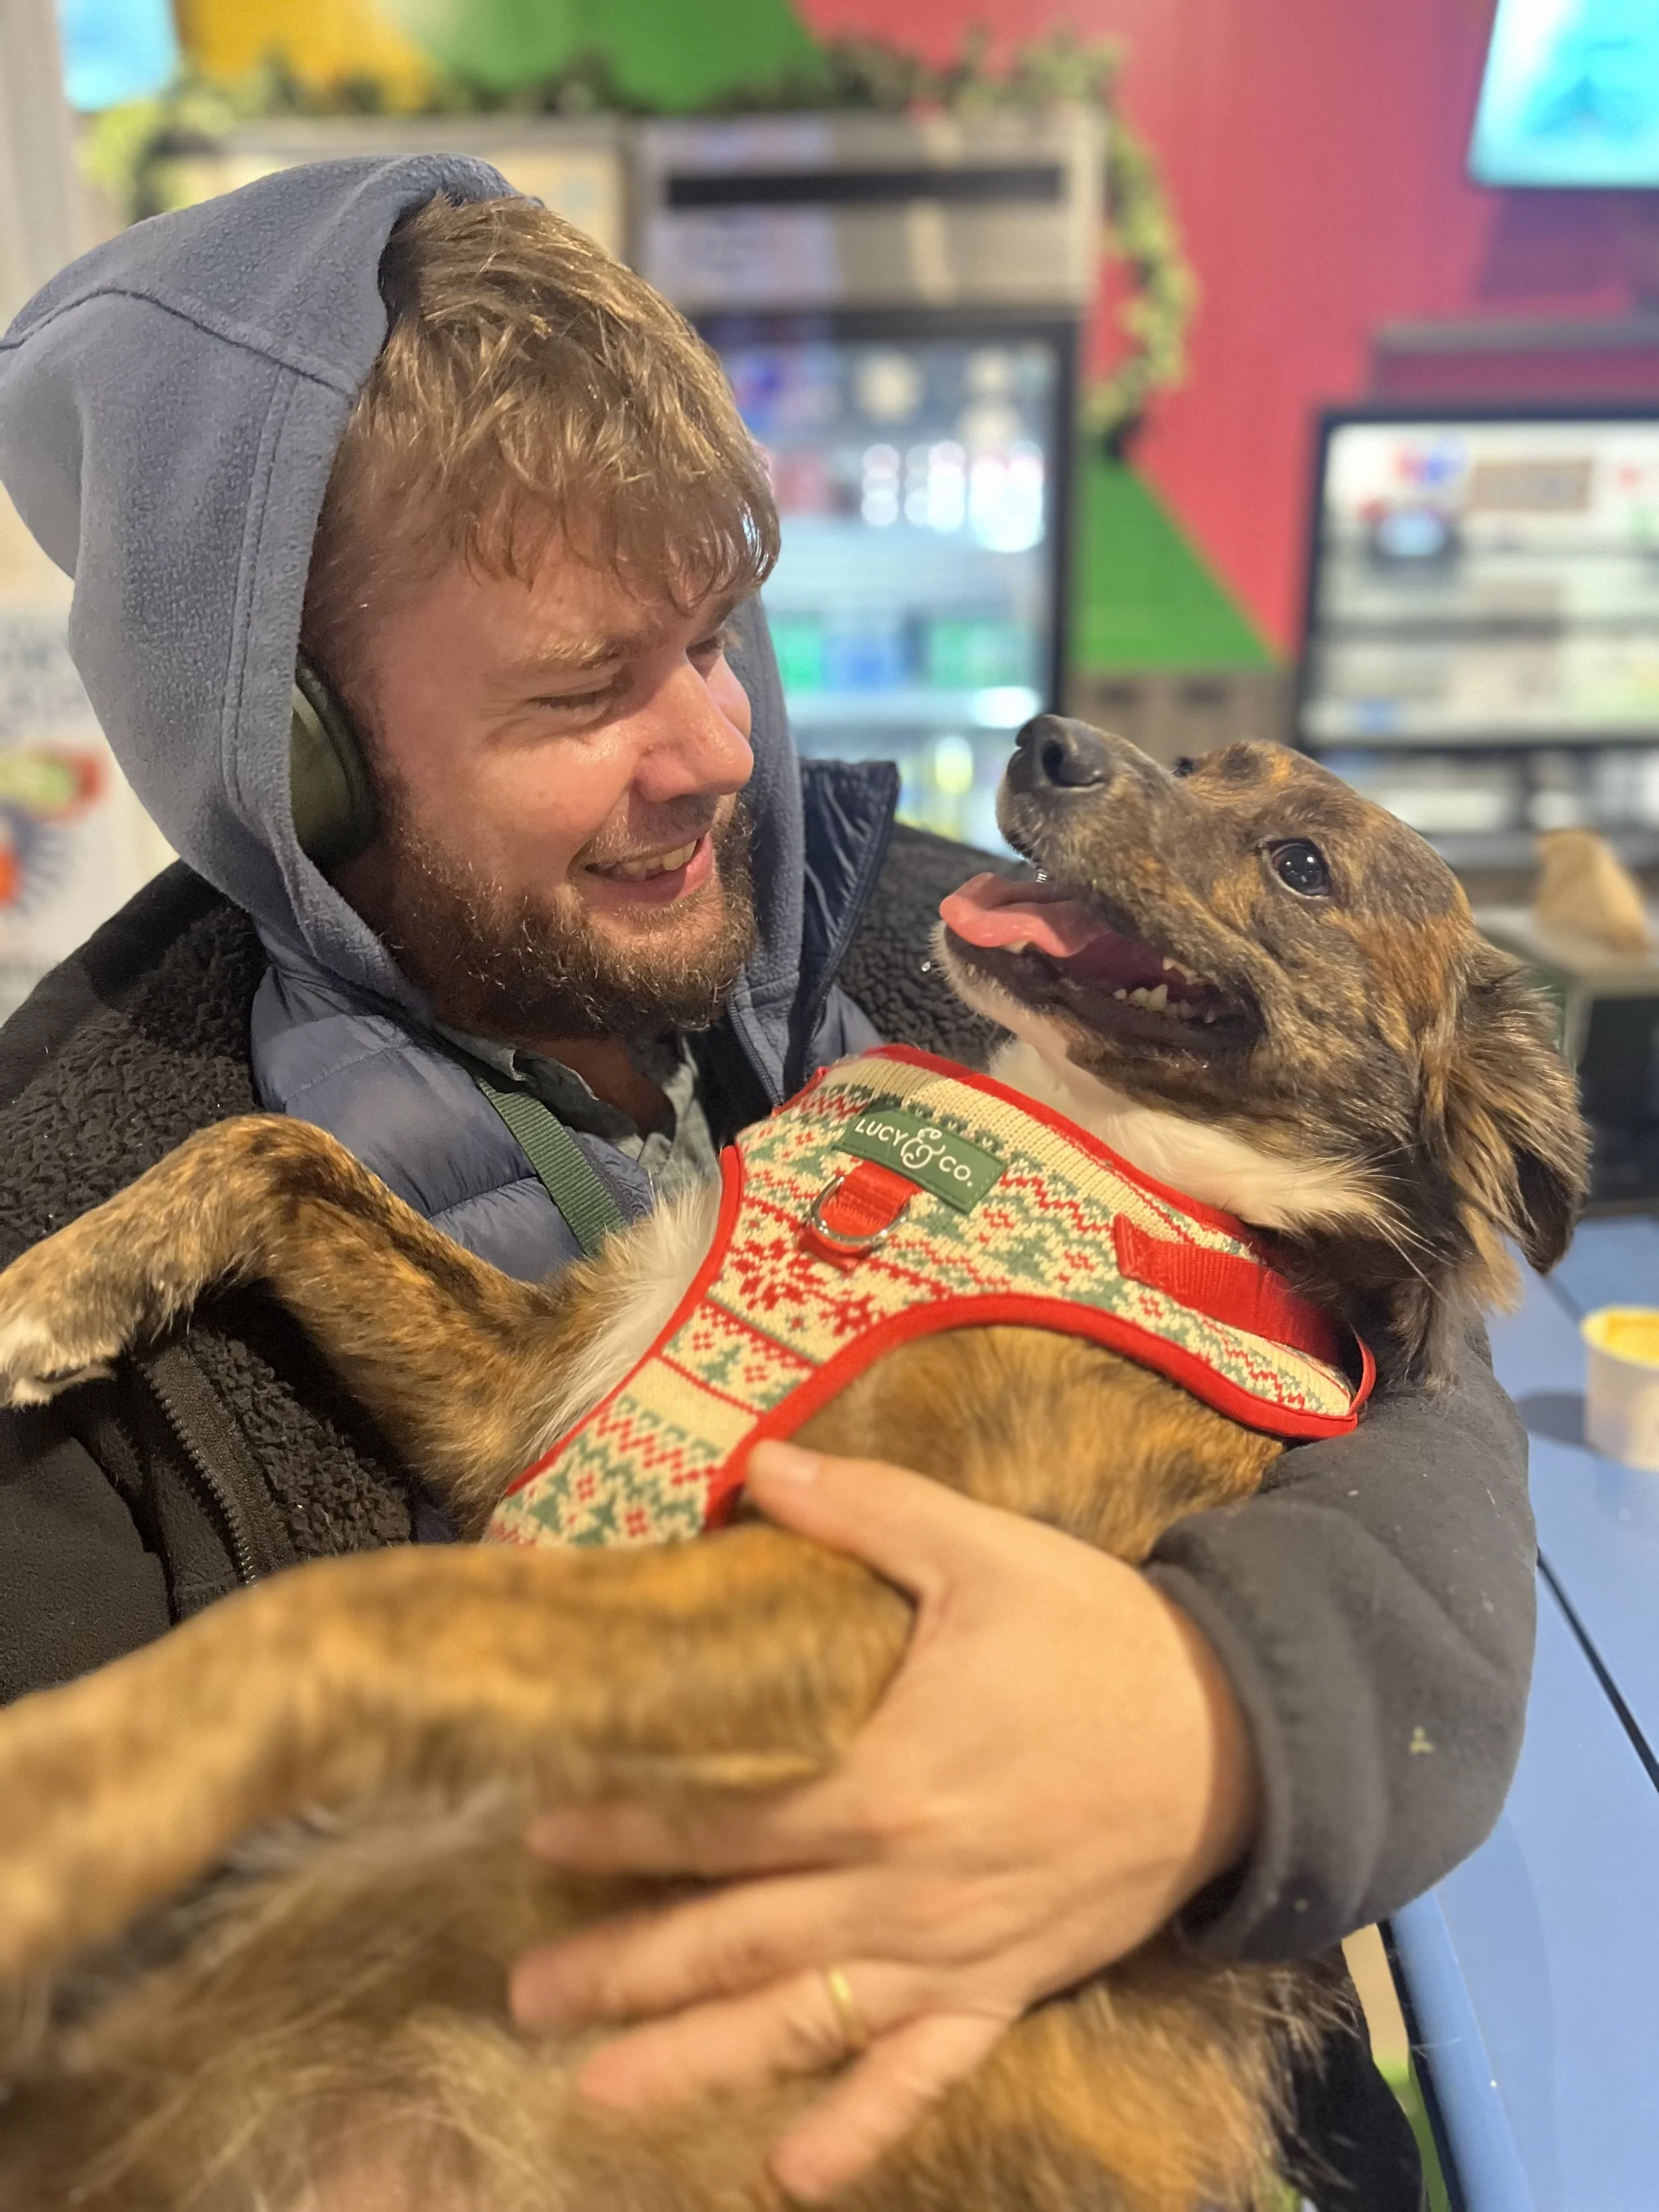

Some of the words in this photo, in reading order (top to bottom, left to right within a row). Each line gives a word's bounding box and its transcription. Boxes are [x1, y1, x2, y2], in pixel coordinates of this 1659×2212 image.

[855, 1119, 908, 1147] LUCY
[901, 1128, 946, 1169] &
[939, 1156, 973, 1187] CO.
